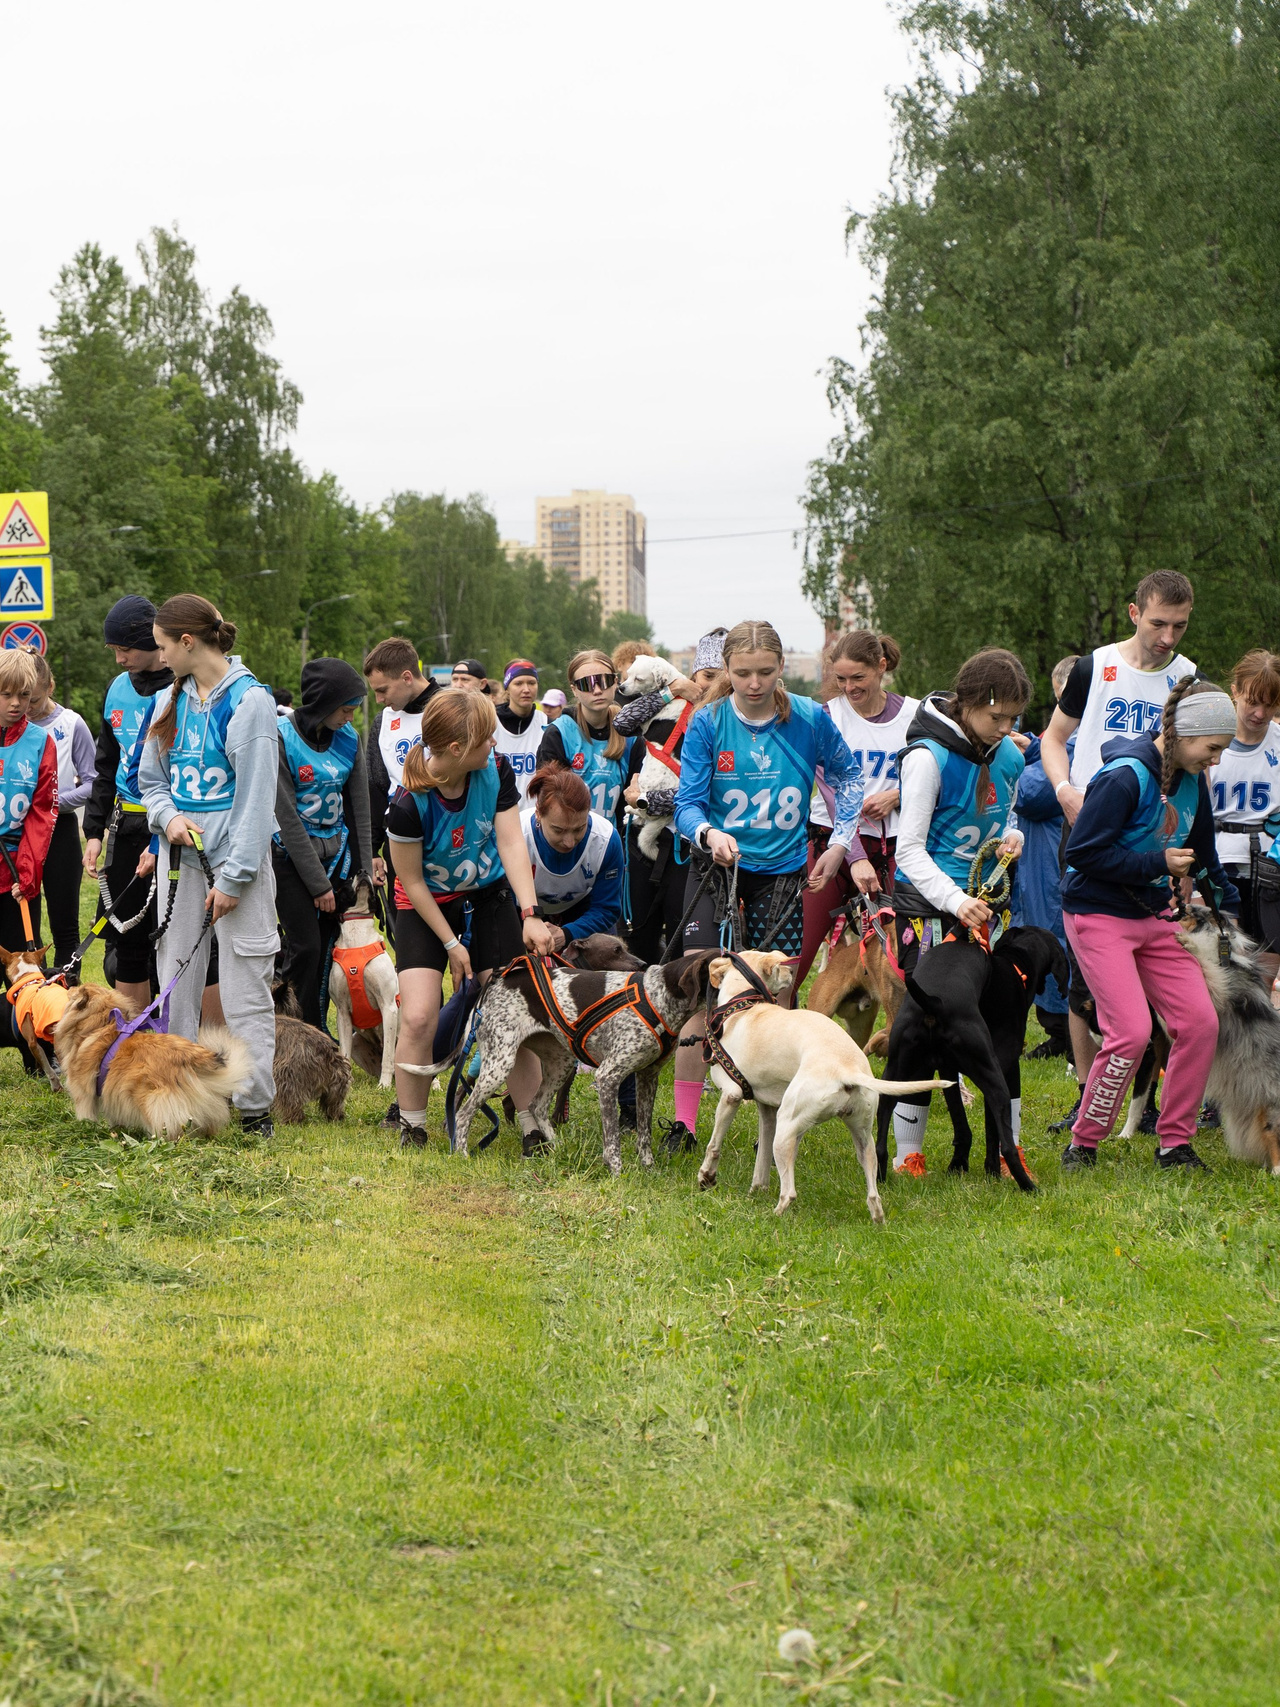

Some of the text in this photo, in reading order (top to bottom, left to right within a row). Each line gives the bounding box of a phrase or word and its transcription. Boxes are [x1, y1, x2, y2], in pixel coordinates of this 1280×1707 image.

[1104, 696, 1164, 734] 217
[395, 733, 422, 766] 3
[722, 786, 802, 830] 218
[1212, 781, 1271, 812] 115
[1084, 1053, 1137, 1127] BEVERLY
